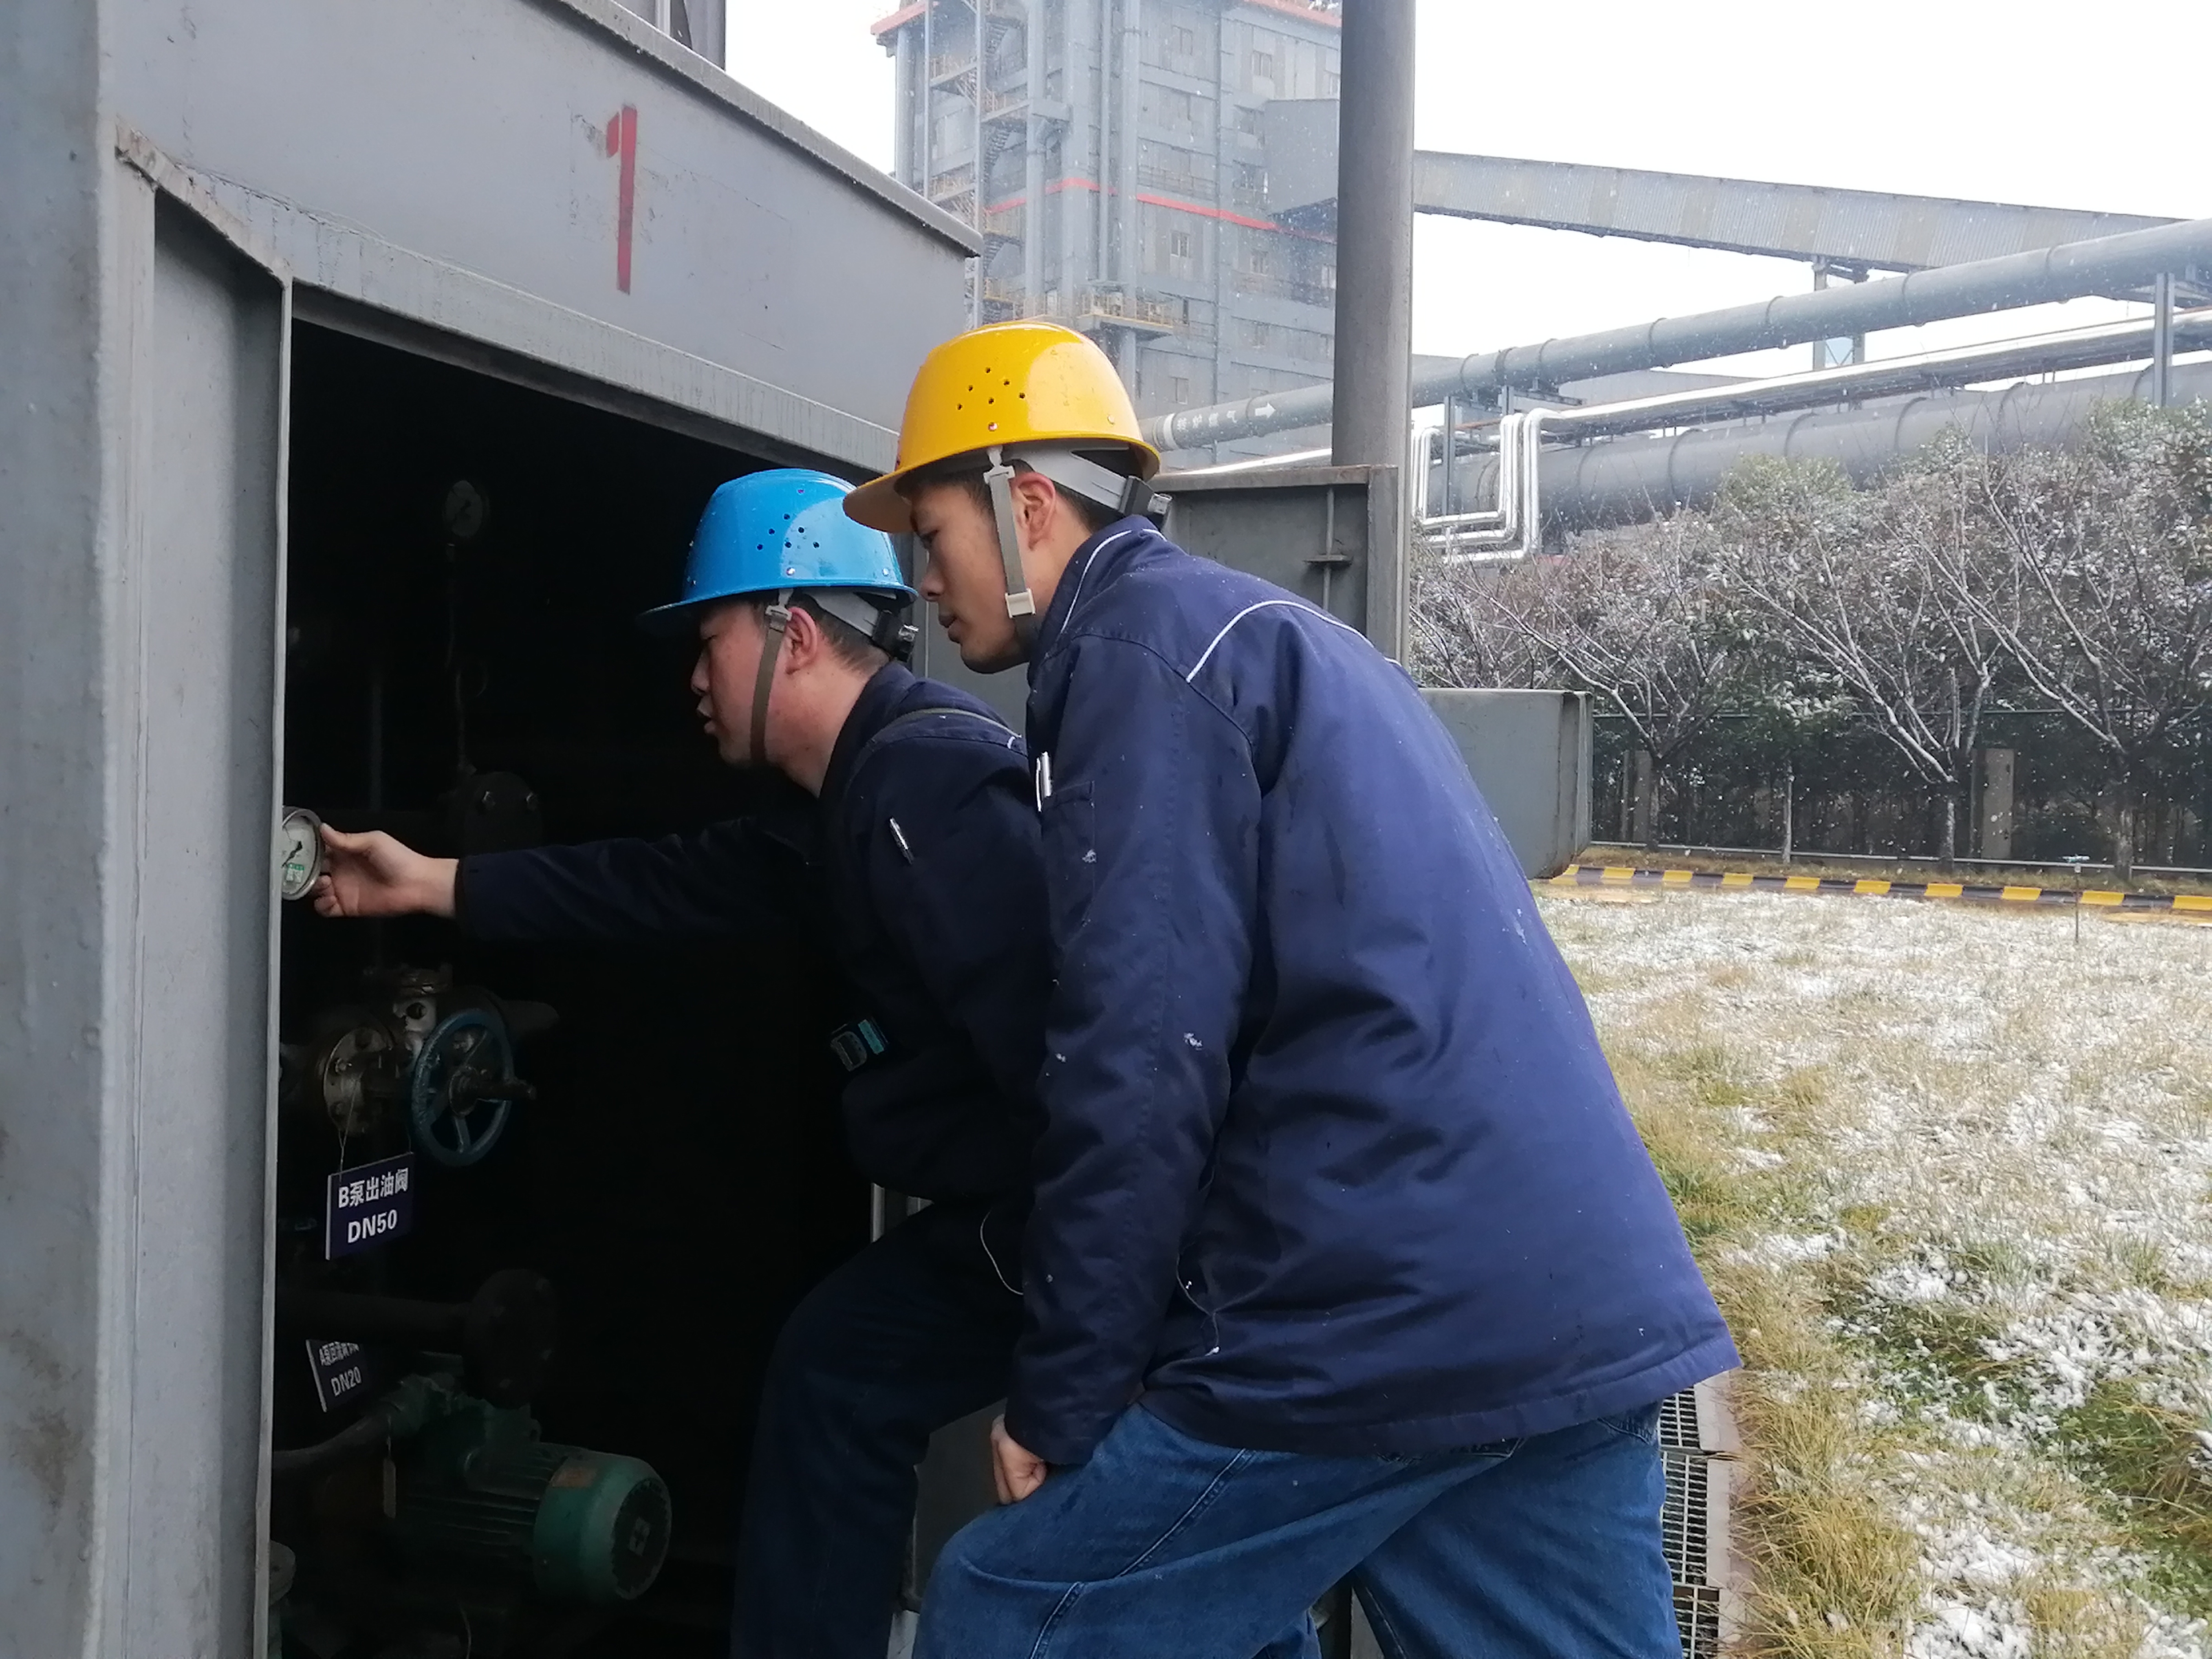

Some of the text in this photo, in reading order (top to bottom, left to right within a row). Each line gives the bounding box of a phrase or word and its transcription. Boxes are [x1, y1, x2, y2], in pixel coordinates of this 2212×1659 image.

[606, 105, 638, 295] 1
[338, 1167, 409, 1208] B泵出油阀
[348, 1209, 397, 1243] DN50
[331, 1366, 362, 1397] DN20
